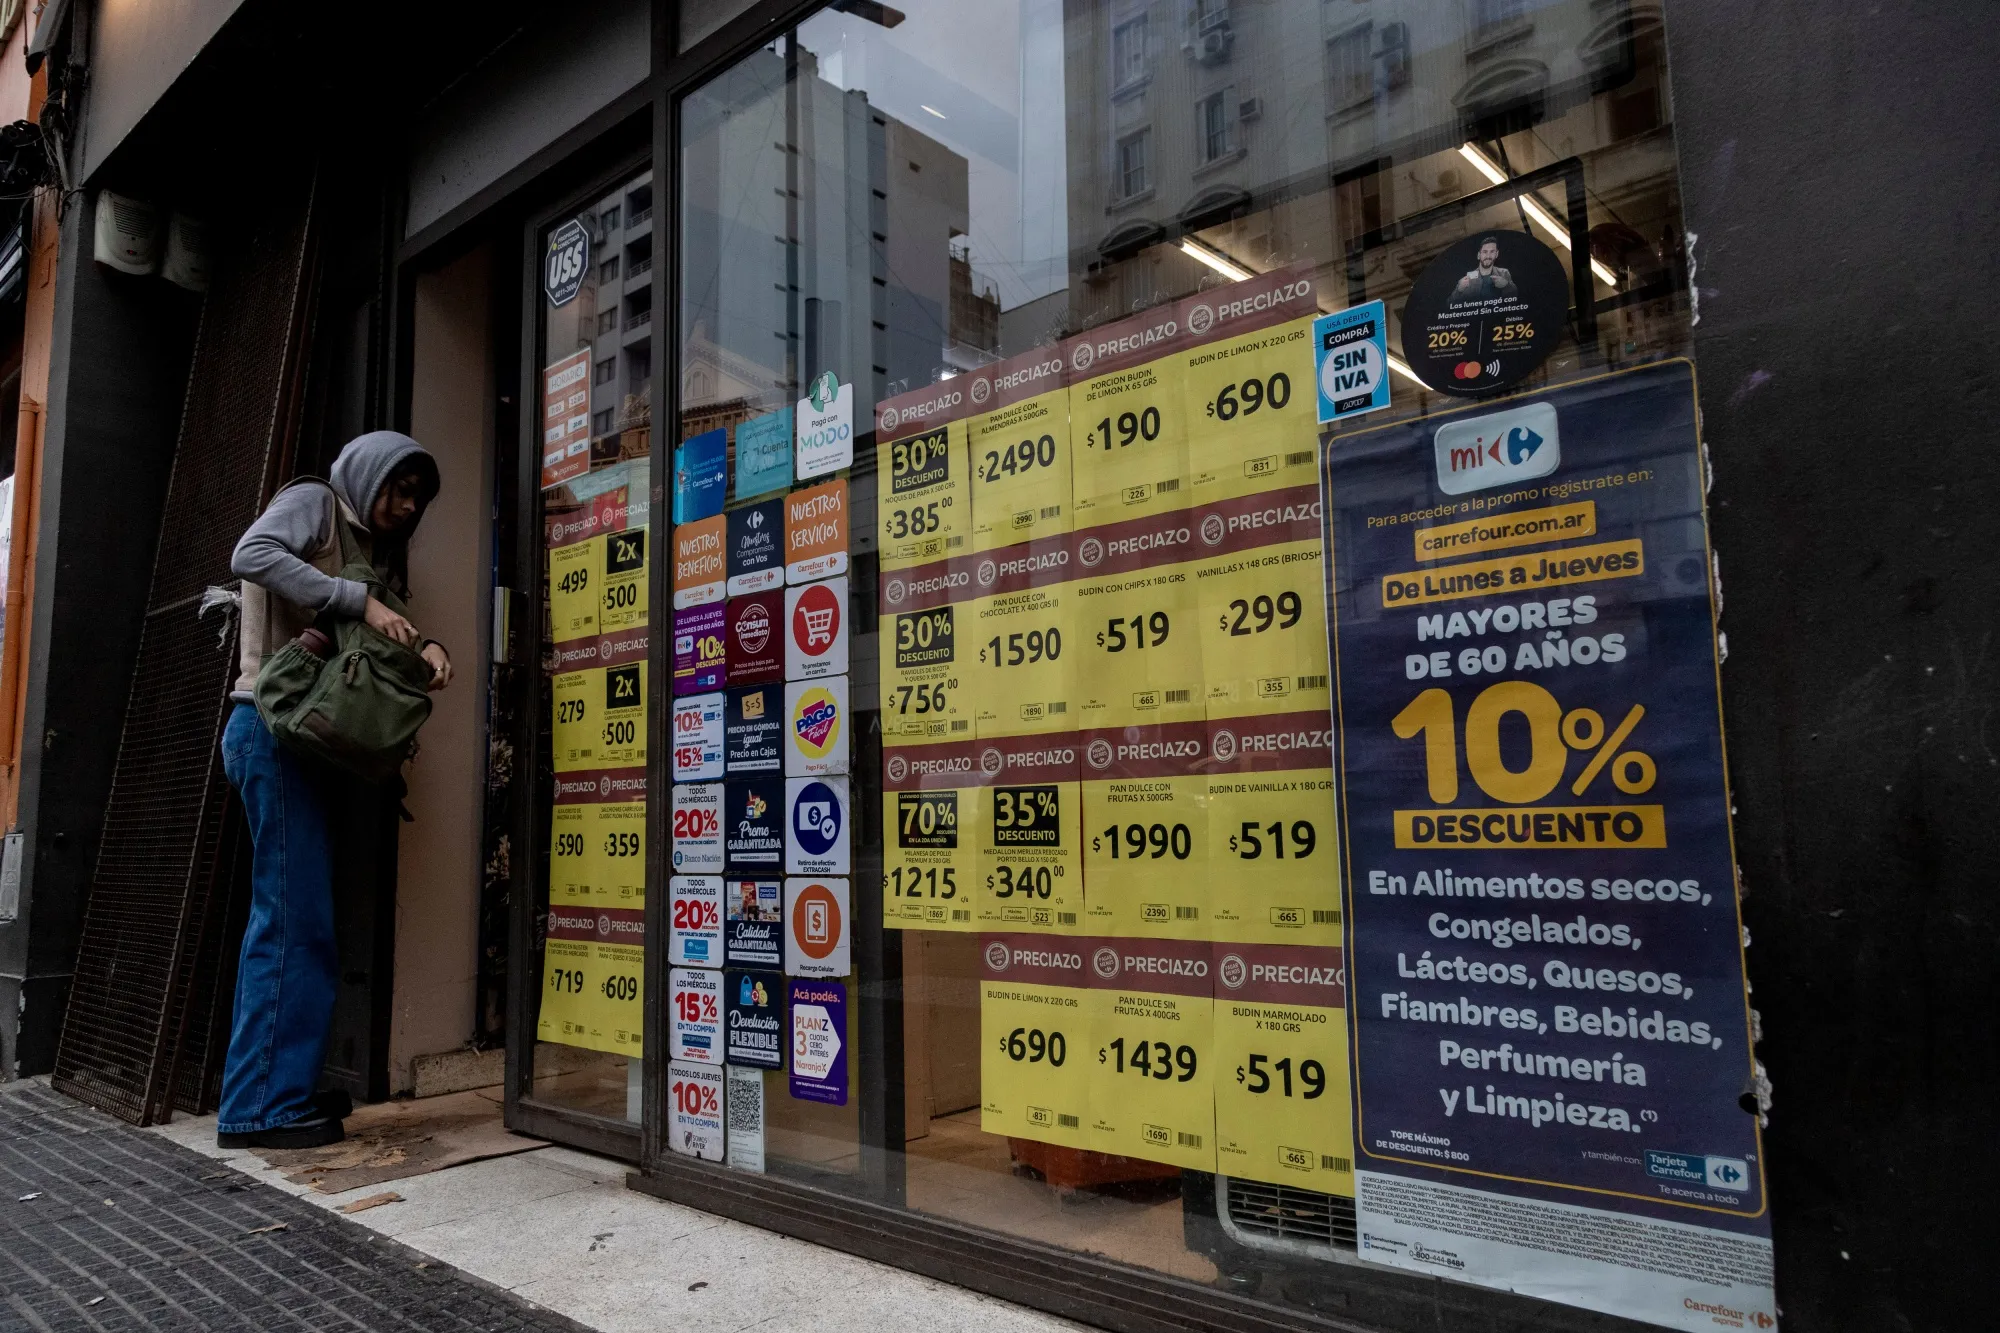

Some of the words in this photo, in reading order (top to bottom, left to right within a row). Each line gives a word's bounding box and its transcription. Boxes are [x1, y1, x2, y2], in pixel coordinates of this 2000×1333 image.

[550, 241, 583, 288] USS
[1219, 281, 1310, 320] PRECIAZO
[1438, 309, 1479, 320] Mastercard
[1493, 303, 1529, 313] Contacto
[1464, 300, 1482, 308] lunes
[1484, 297, 1502, 307] pagá
[1098, 322, 1177, 358] PRECIAZO
[1329, 324, 1369, 345] COMPRÁ
[1428, 331, 1467, 348] 20%
[1493, 323, 1534, 342] 25%
[1189, 355, 1215, 367] BUDIN
[1217, 352, 1228, 360] DE
[1230, 344, 1260, 356] LIMON
[1270, 336, 1286, 346] 220
[1288, 330, 1305, 342] GRS
[1334, 348, 1367, 372] SIN
[994, 359, 1062, 392] PRECIAZO
[1091, 376, 1126, 391] PORCION
[1128, 369, 1152, 382] BUDIN
[1098, 388, 1123, 398] LIMON
[1132, 382, 1142, 390] 65
[1143, 377, 1157, 387] GRS
[1335, 370, 1369, 393] IVA
[902, 392, 961, 421] PRECIAZO
[1207, 373, 1290, 420] $690
[801, 423, 849, 452] MODO
[1087, 407, 1160, 450] $190
[894, 435, 946, 476] 30%
[978, 435, 1055, 482] $2490
[1450, 438, 1483, 472] mi
[896, 469, 944, 488] DESCUENTO
[791, 491, 840, 524] NUESTROS
[1367, 515, 1397, 528] Para
[1401, 506, 1457, 523] acceder
[1461, 502, 1469, 512] a
[1472, 498, 1484, 511] la
[1487, 487, 1538, 510] promo
[1542, 473, 1624, 502] registrate
[1627, 469, 1654, 485] en:
[565, 516, 598, 533] PRECIAZO
[792, 520, 838, 550] SERVICIOS
[1423, 512, 1586, 551] carrefour.com.ar
[617, 540, 636, 562] 2x
[680, 531, 719, 558] NUESTROS
[1108, 528, 1190, 556] PRECIAZO
[678, 554, 722, 580] BENEFICIOS
[1000, 551, 1068, 576] PRECIAZO
[1386, 579, 1420, 600] De
[1424, 567, 1504, 597] Lunes
[1509, 567, 1527, 584] a
[1532, 551, 1639, 582] Jueves
[558, 569, 587, 593] $499
[909, 572, 969, 595] PRECIAZO
[603, 584, 636, 610] $500
[1220, 591, 1301, 636] $299
[1417, 596, 1598, 641] MAYORES
[898, 614, 951, 650] 30%
[1097, 612, 1169, 652] $519
[900, 648, 949, 662] DESCUENTO
[980, 628, 1061, 667] $1590
[1406, 653, 1452, 680] DE
[1458, 646, 1506, 675] 60
[1514, 631, 1626, 670] AÑOS
[557, 699, 584, 724] $279
[796, 704, 836, 733] PAGO
[602, 721, 635, 745] $500
[808, 721, 829, 741] Fácil
[1391, 681, 1657, 804] 10%
[1008, 750, 1074, 767] PRECIAZO
[1118, 741, 1200, 760] PRECIAZO
[912, 758, 971, 774] PRECIAZO
[996, 792, 1056, 827] 35%
[1108, 794, 1138, 802] FRUTAS
[1147, 793, 1173, 801] 500GRS
[674, 809, 718, 838] 20%
[901, 802, 954, 835] 70%
[1412, 811, 1643, 843] DESCUENTO
[555, 834, 583, 856] $590
[604, 833, 639, 857] $359
[998, 831, 1055, 840] DESCUENTO
[1093, 823, 1191, 860] $1990
[1230, 821, 1316, 859] $519
[702, 852, 721, 863] Nación
[883, 867, 956, 899] $1215
[1369, 870, 1407, 895] En
[1413, 869, 1585, 899] Alimentos
[1591, 878, 1712, 906] secos,
[674, 900, 718, 930] 20%
[1428, 912, 1641, 950] Congelados,
[1014, 950, 1081, 969] PRECIAZO
[1125, 957, 1208, 976] PRECIAZO
[551, 969, 583, 993] $719
[601, 976, 637, 1001] $609
[1398, 951, 1538, 990] Lácteos,
[1543, 960, 1694, 1000] Quesos,
[675, 992, 717, 1022] 15%
[794, 988, 810, 1000] Acá
[811, 991, 840, 1002] podés.
[1233, 1008, 1260, 1017] BUDIN
[1263, 1010, 1326, 1023] MARMOLADO
[1256, 1021, 1262, 1029] X
[1265, 1022, 1280, 1030] 180
[1283, 1023, 1300, 1032] GRS
[1381, 993, 1548, 1034] Fiambres,
[1554, 1005, 1722, 1050] Bebidas,
[730, 1031, 778, 1050] FLEXIBLE
[1000, 1028, 1066, 1067] $690
[1099, 1038, 1197, 1082] $1439
[1439, 1040, 1647, 1086] Perfumería
[1237, 1054, 1326, 1099] $519
[672, 1081, 718, 1115] 10%
[1440, 1089, 1460, 1116] y
[695, 1117, 719, 1129] COMPRA
[1376, 1140, 1388, 1148] DE
[1389, 1142, 1443, 1157] DESCUENTO:
[1391, 1130, 1413, 1141] TOPE
[1415, 1133, 1450, 1146] MÁXIMO
[1582, 1151, 1586, 1159] y
[1587, 1151, 1623, 1163] también
[1650, 1155, 1687, 1168] Tarjeta
[1651, 1165, 1703, 1179] Carrefour
[1659, 1184, 1670, 1193] Te
[1672, 1188, 1706, 1199] acerca
[1714, 1194, 1739, 1205] todo
[1684, 1298, 1744, 1320] Carrefour
[1712, 1317, 1744, 1328] express
